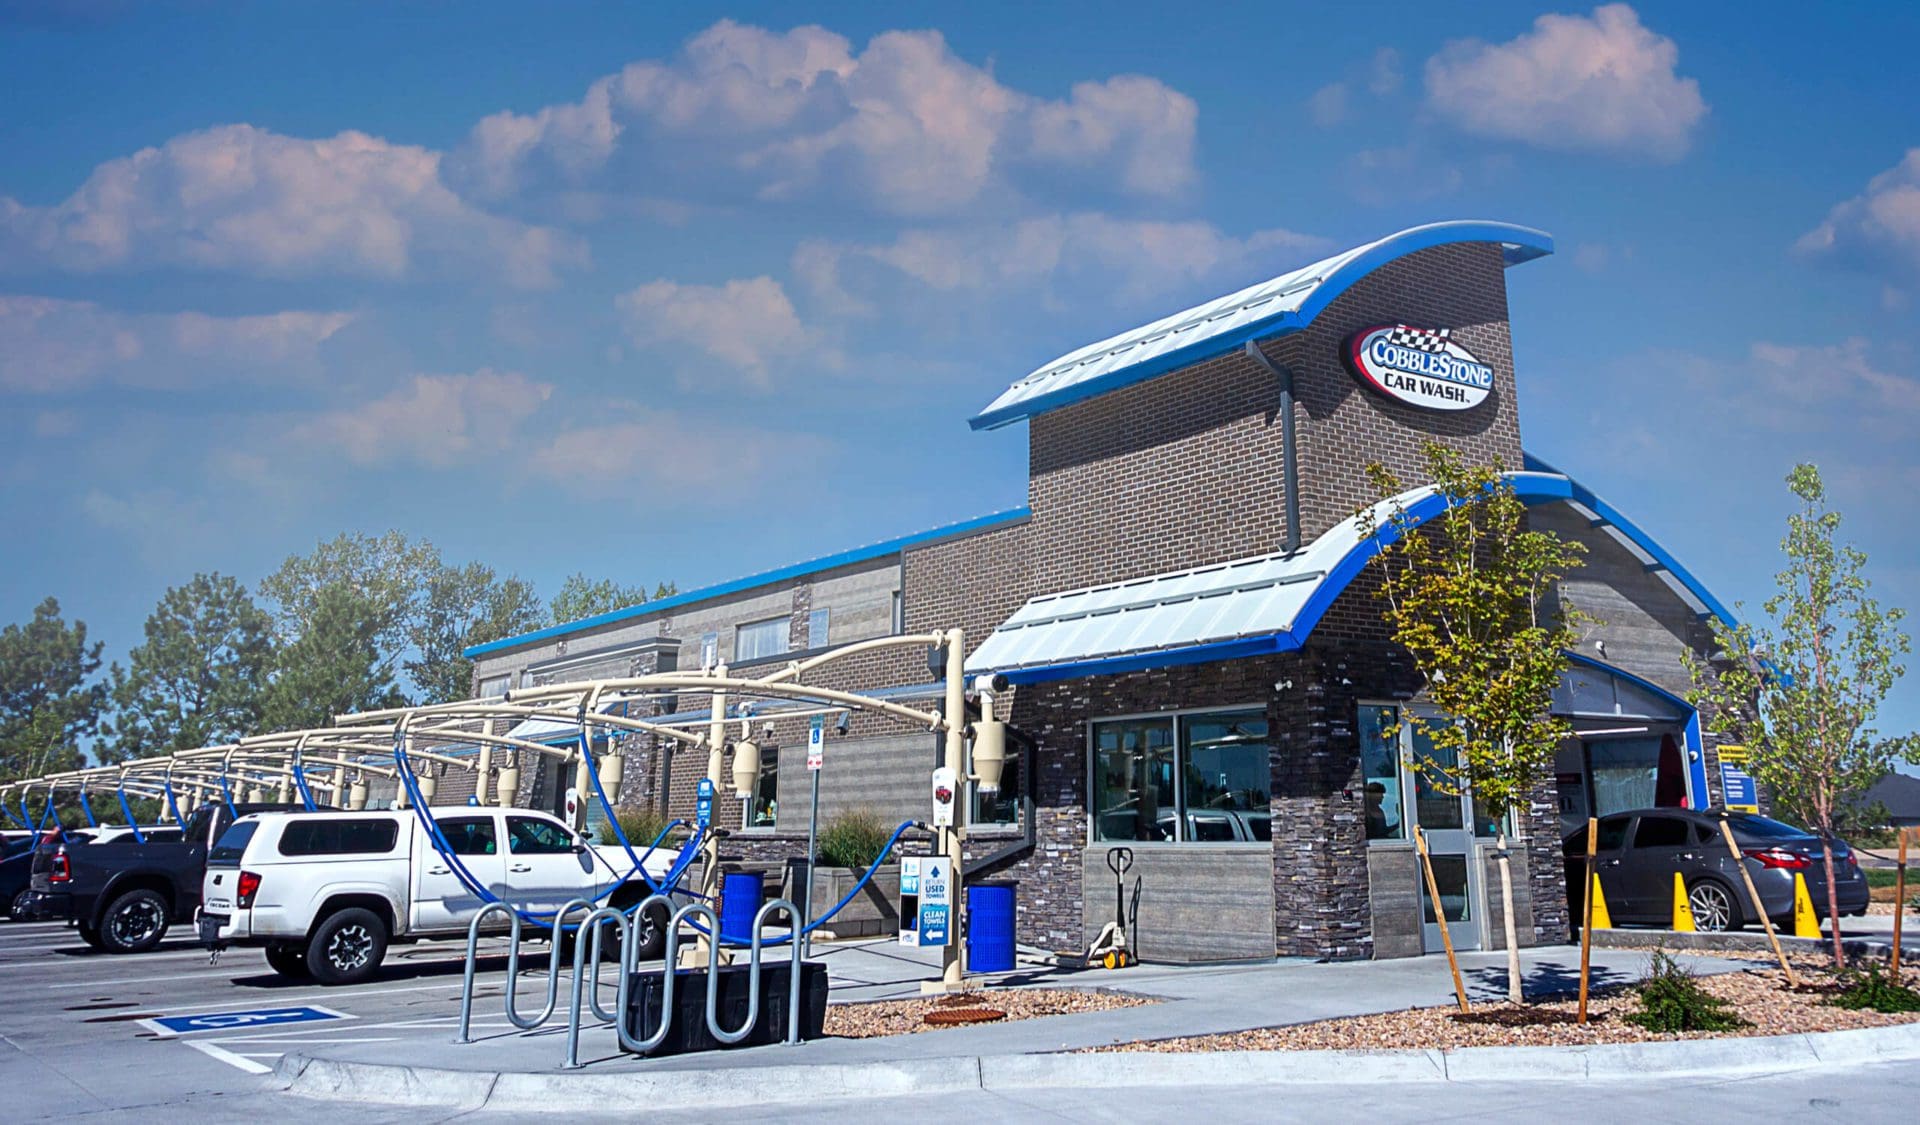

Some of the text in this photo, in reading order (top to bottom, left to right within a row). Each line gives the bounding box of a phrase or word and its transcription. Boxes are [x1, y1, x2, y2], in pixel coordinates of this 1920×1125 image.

[1373, 341, 1492, 386] COBBLESTONE
[1384, 373, 1465, 403] CAR WASH
[925, 885, 945, 893] USED
[924, 910, 946, 918] CLEAN
